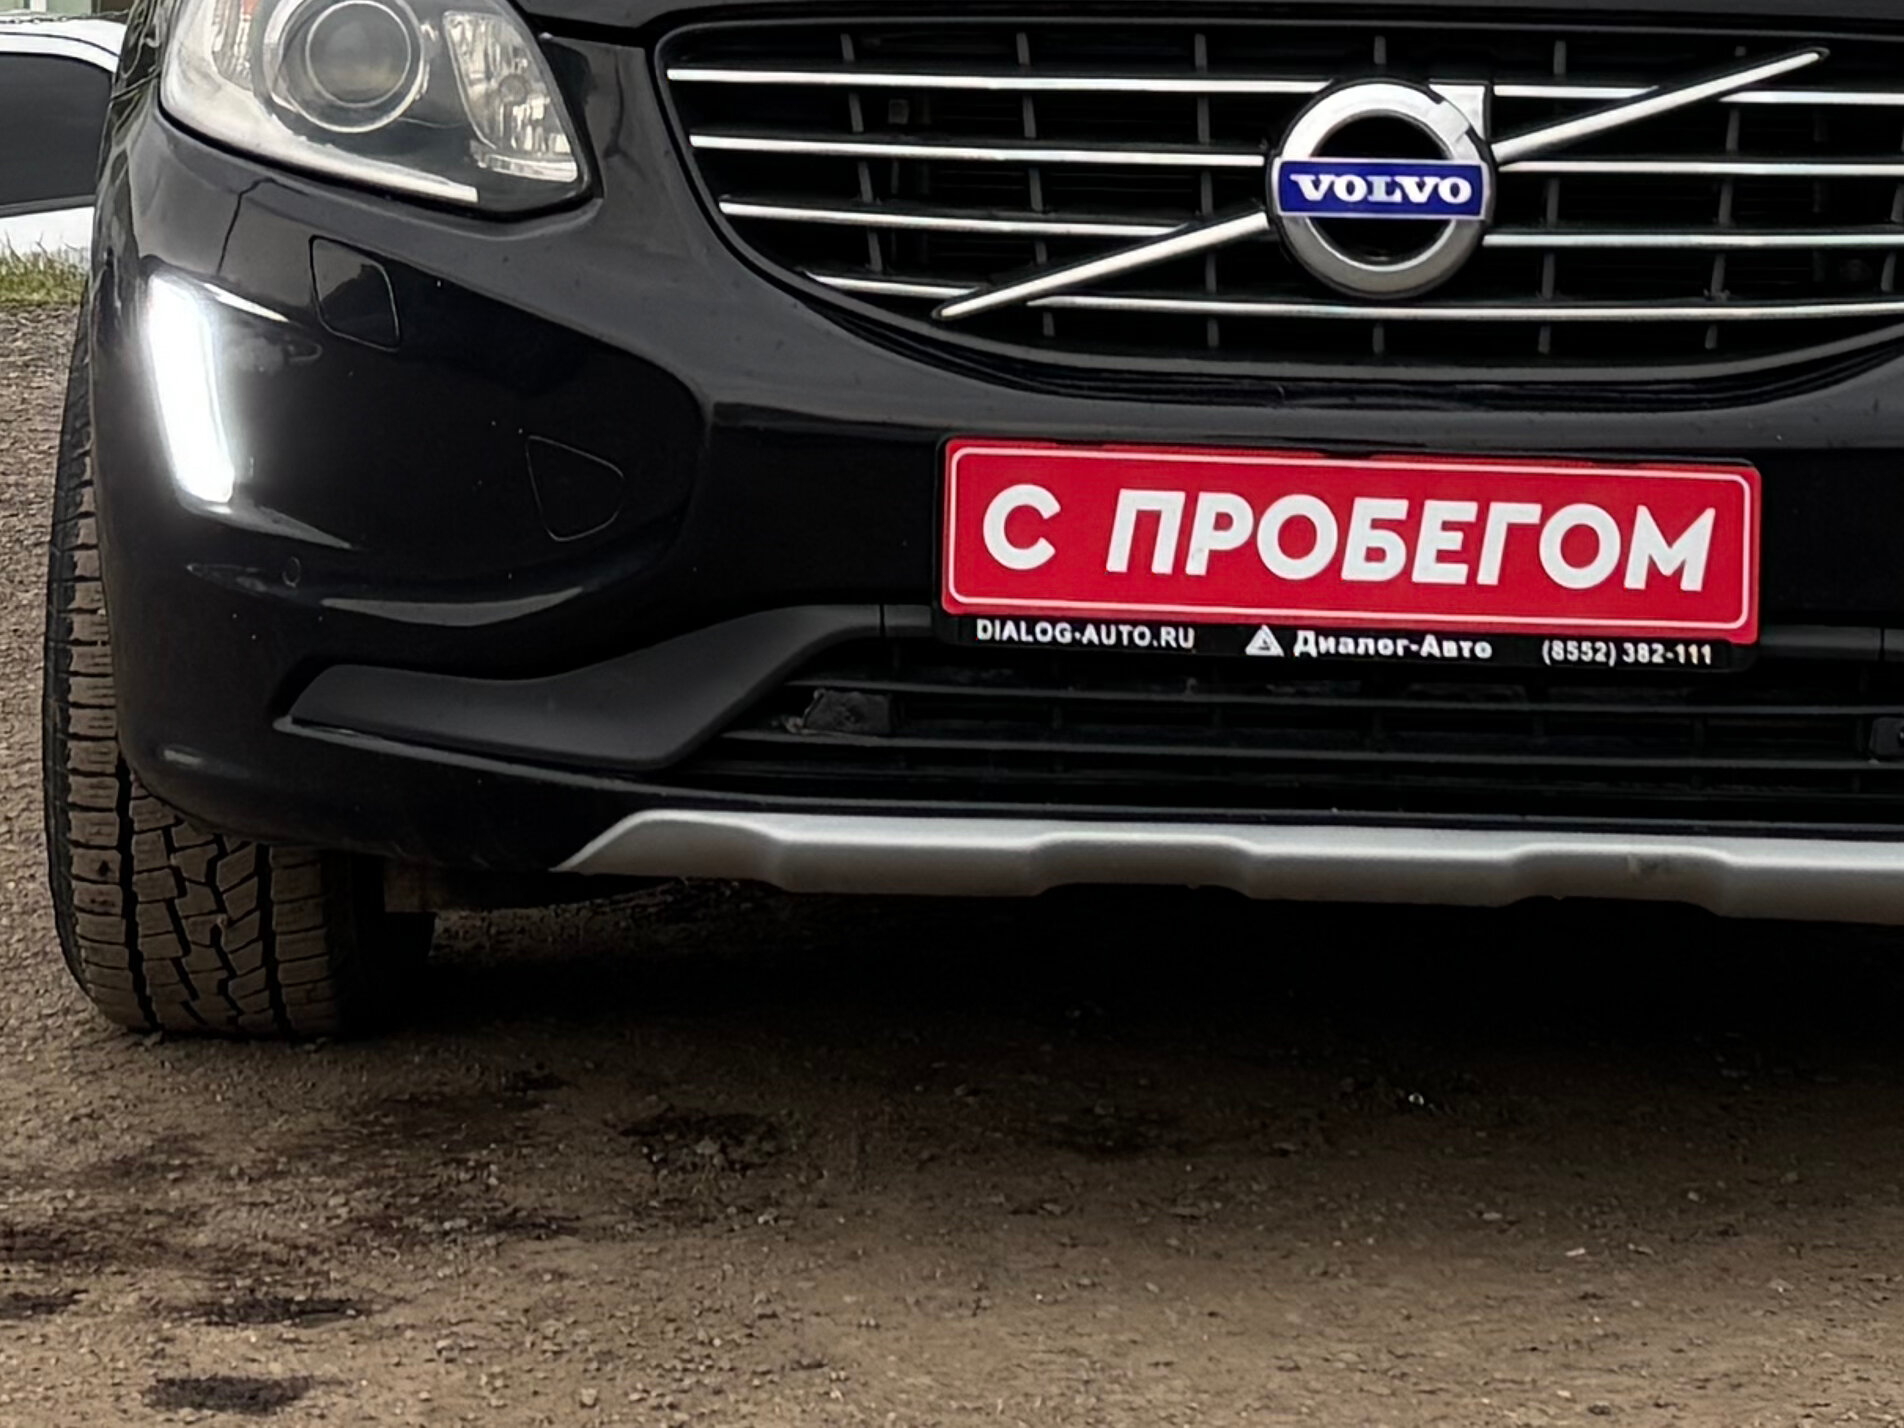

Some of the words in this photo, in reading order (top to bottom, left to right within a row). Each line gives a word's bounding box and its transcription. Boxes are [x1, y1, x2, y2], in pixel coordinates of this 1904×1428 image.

[1289, 173, 1472, 204] VOLVO
[982, 482, 1062, 571] С
[1106, 487, 1717, 592] ПРОБЕГОМ
[1294, 630, 1492, 659] Диалог-Авто
[1541, 640, 1616, 666] (8552)
[1622, 642, 1712, 665] 382-111
